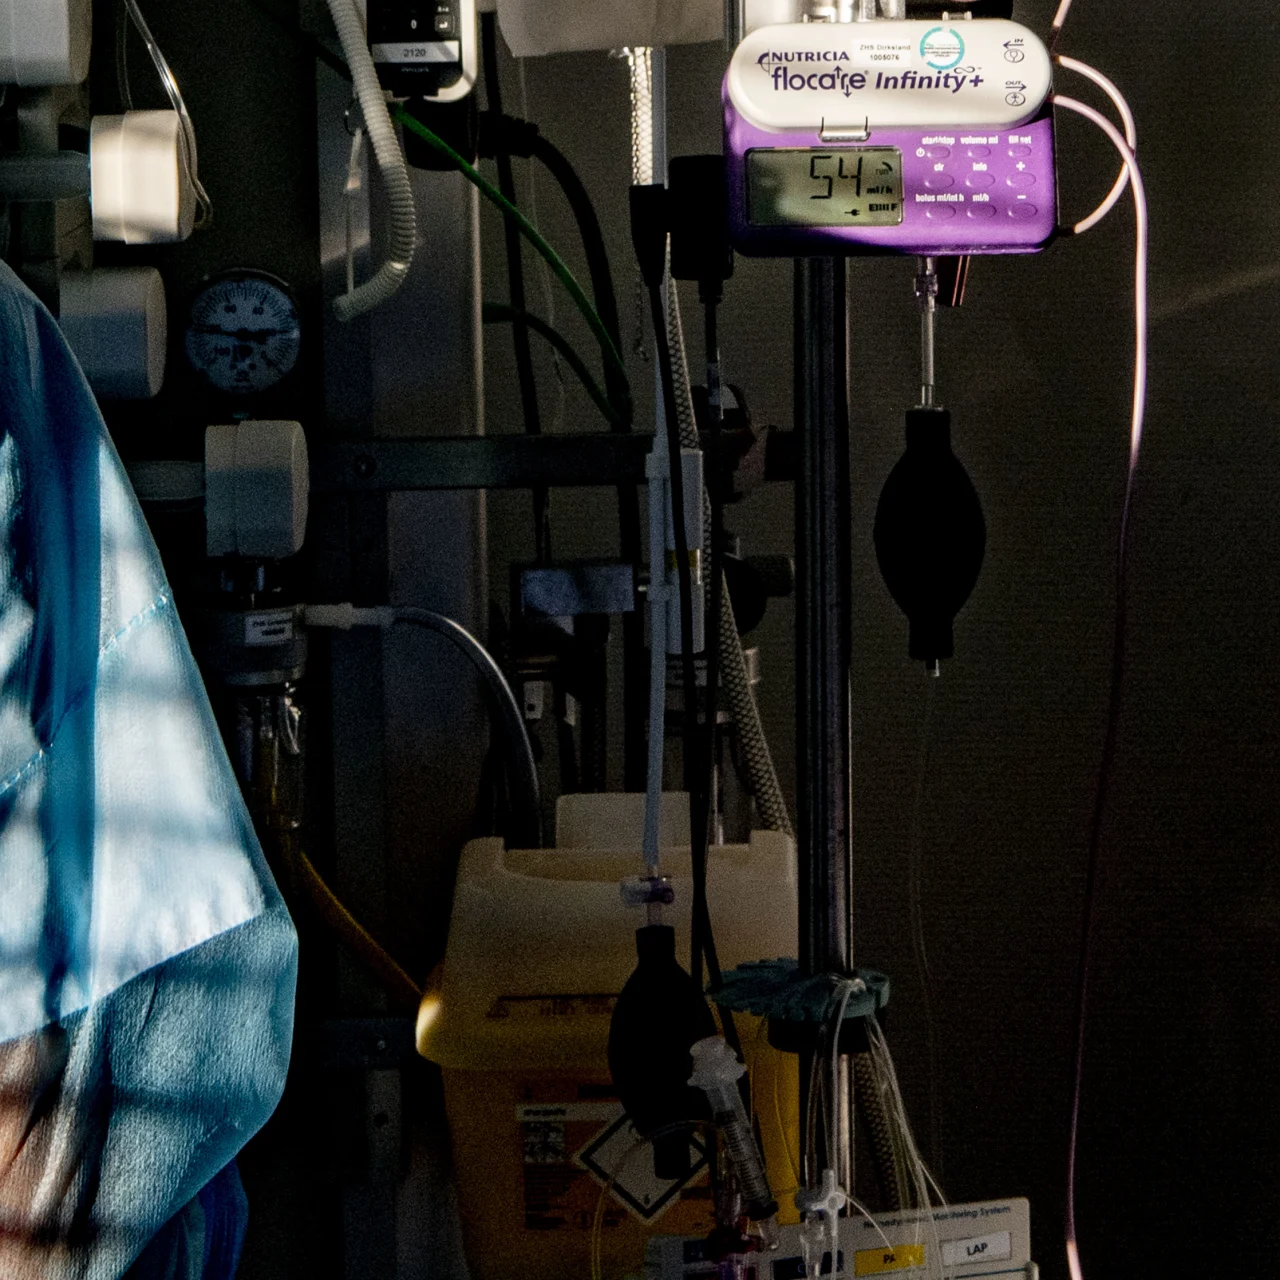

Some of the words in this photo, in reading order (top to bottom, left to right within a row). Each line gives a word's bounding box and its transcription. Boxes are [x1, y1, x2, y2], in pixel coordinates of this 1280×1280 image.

[403, 48, 426, 58] 2120
[771, 50, 850, 63] NUTRICIA
[771, 66, 867, 92] flocare
[960, 135, 987, 144] volume
[809, 155, 863, 199] 54
[867, 185, 893, 195] ml/h
[967, 1242, 988, 1256] LAP
